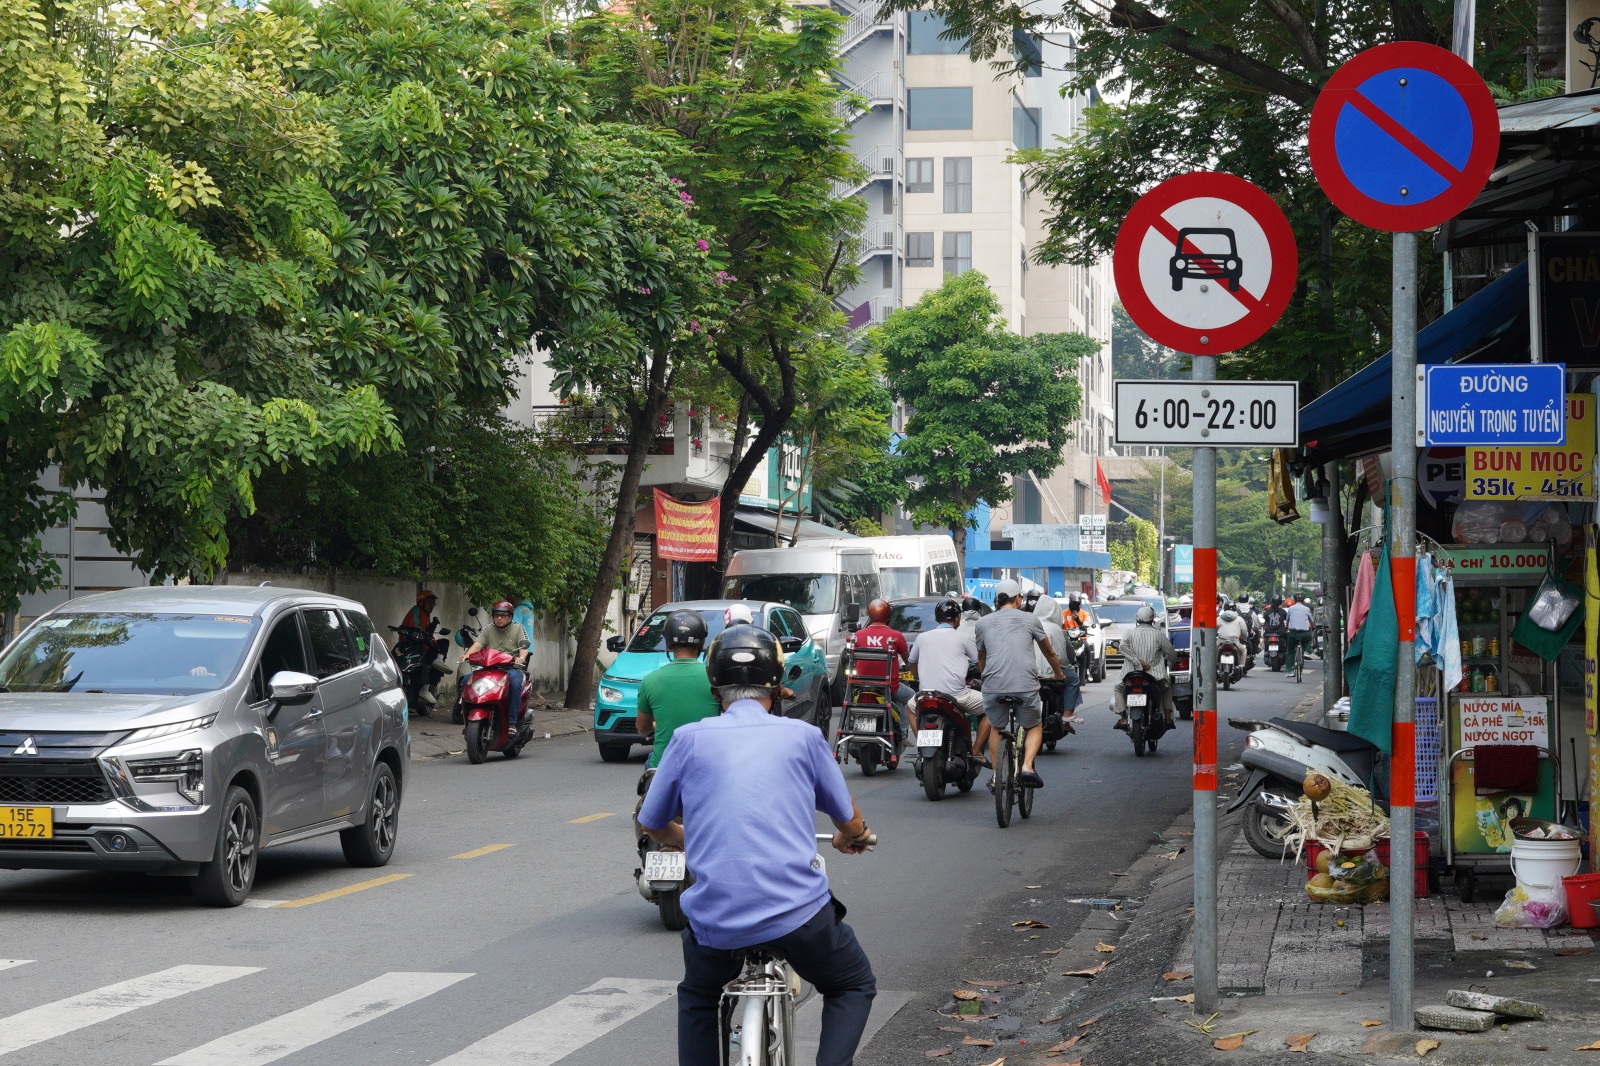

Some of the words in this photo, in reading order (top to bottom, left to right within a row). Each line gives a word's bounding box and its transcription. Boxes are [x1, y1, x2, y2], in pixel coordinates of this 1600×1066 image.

[1460, 369, 1529, 393] ĐƯỜNG
[1135, 398, 1277, 430] 6:00-22:00
[1431, 402, 1475, 433] NGUYỄN
[1480, 409, 1517, 438] TRỌNG
[1522, 399, 1560, 433] TUYỂN
[1473, 446, 1522, 472] BÚN
[1530, 451, 1583, 477] MỌC
[1426, 463, 1466, 482] PE
[1472, 477, 1516, 497] 35k
[1490, 554, 1547, 568] 10.000
[866, 635, 884, 647] NK
[1463, 700, 1498, 713] NƯỚC
[1501, 700, 1522, 713] MÍA
[1464, 715, 1479, 727] CÀ
[1482, 714, 1503, 727] PHÊ
[1464, 729, 1499, 742] NƯỚC
[1502, 731, 1535, 743] NGỌT
[10, 808, 35, 822] 15E
[652, 854, 679, 866] 59-T1
[647, 866, 683, 878] 387.59
